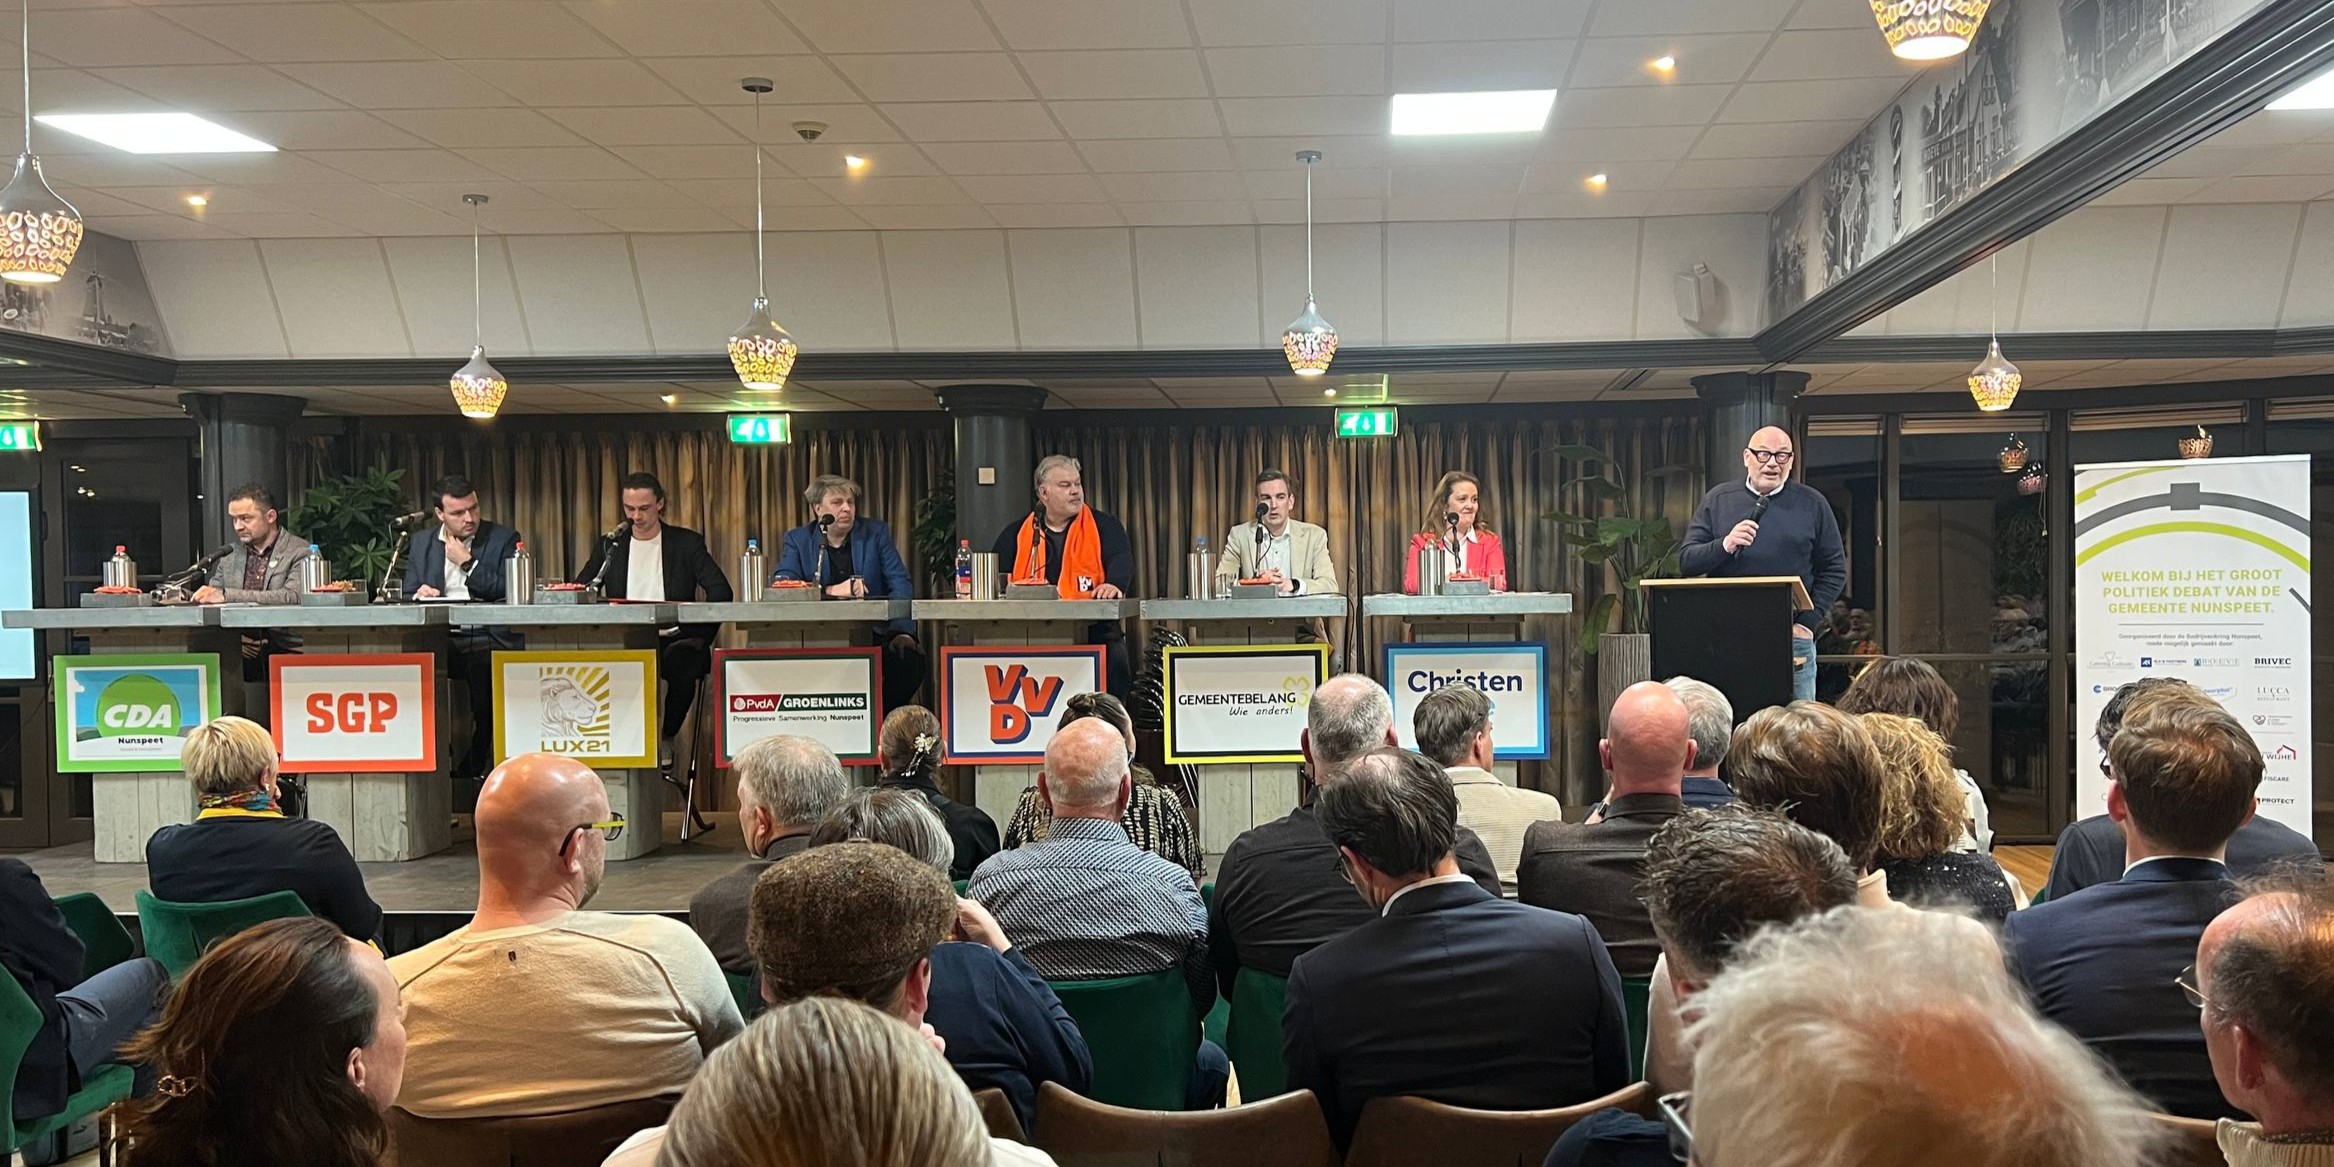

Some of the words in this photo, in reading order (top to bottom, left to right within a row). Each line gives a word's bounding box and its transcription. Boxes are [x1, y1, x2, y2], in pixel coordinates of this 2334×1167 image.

[2101, 571, 2164, 582] WELKOM
[2168, 570, 2192, 581] BIJ
[2196, 570, 2225, 581] HET
[2229, 569, 2282, 581] GROOT
[2103, 587, 2168, 598] POLITIEK
[2173, 586, 2221, 597] DEBAT
[2225, 586, 2257, 597] VAN
[2261, 585, 2281, 597] DE
[2108, 602, 2187, 614] GEMEENTE
[2191, 602, 2274, 613] NUNSPEET.
[2254, 657, 2291, 665] BRIVEC
[746, 699, 775, 709] PvdA
[783, 697, 865, 708] GROENLINKS
[1178, 692, 1296, 705] GEMEENTEBELANG
[104, 704, 172, 728] CDA
[306, 692, 398, 733] SGP
[1229, 706, 1248, 716] Wie
[1255, 705, 1293, 716] anders!
[733, 715, 776, 723] Progressieve
[779, 714, 827, 723] Samenwerking
[830, 714, 864, 722] Nunspeet
[118, 737, 164, 745] Nunspeet
[541, 740, 610, 752] LUX21
